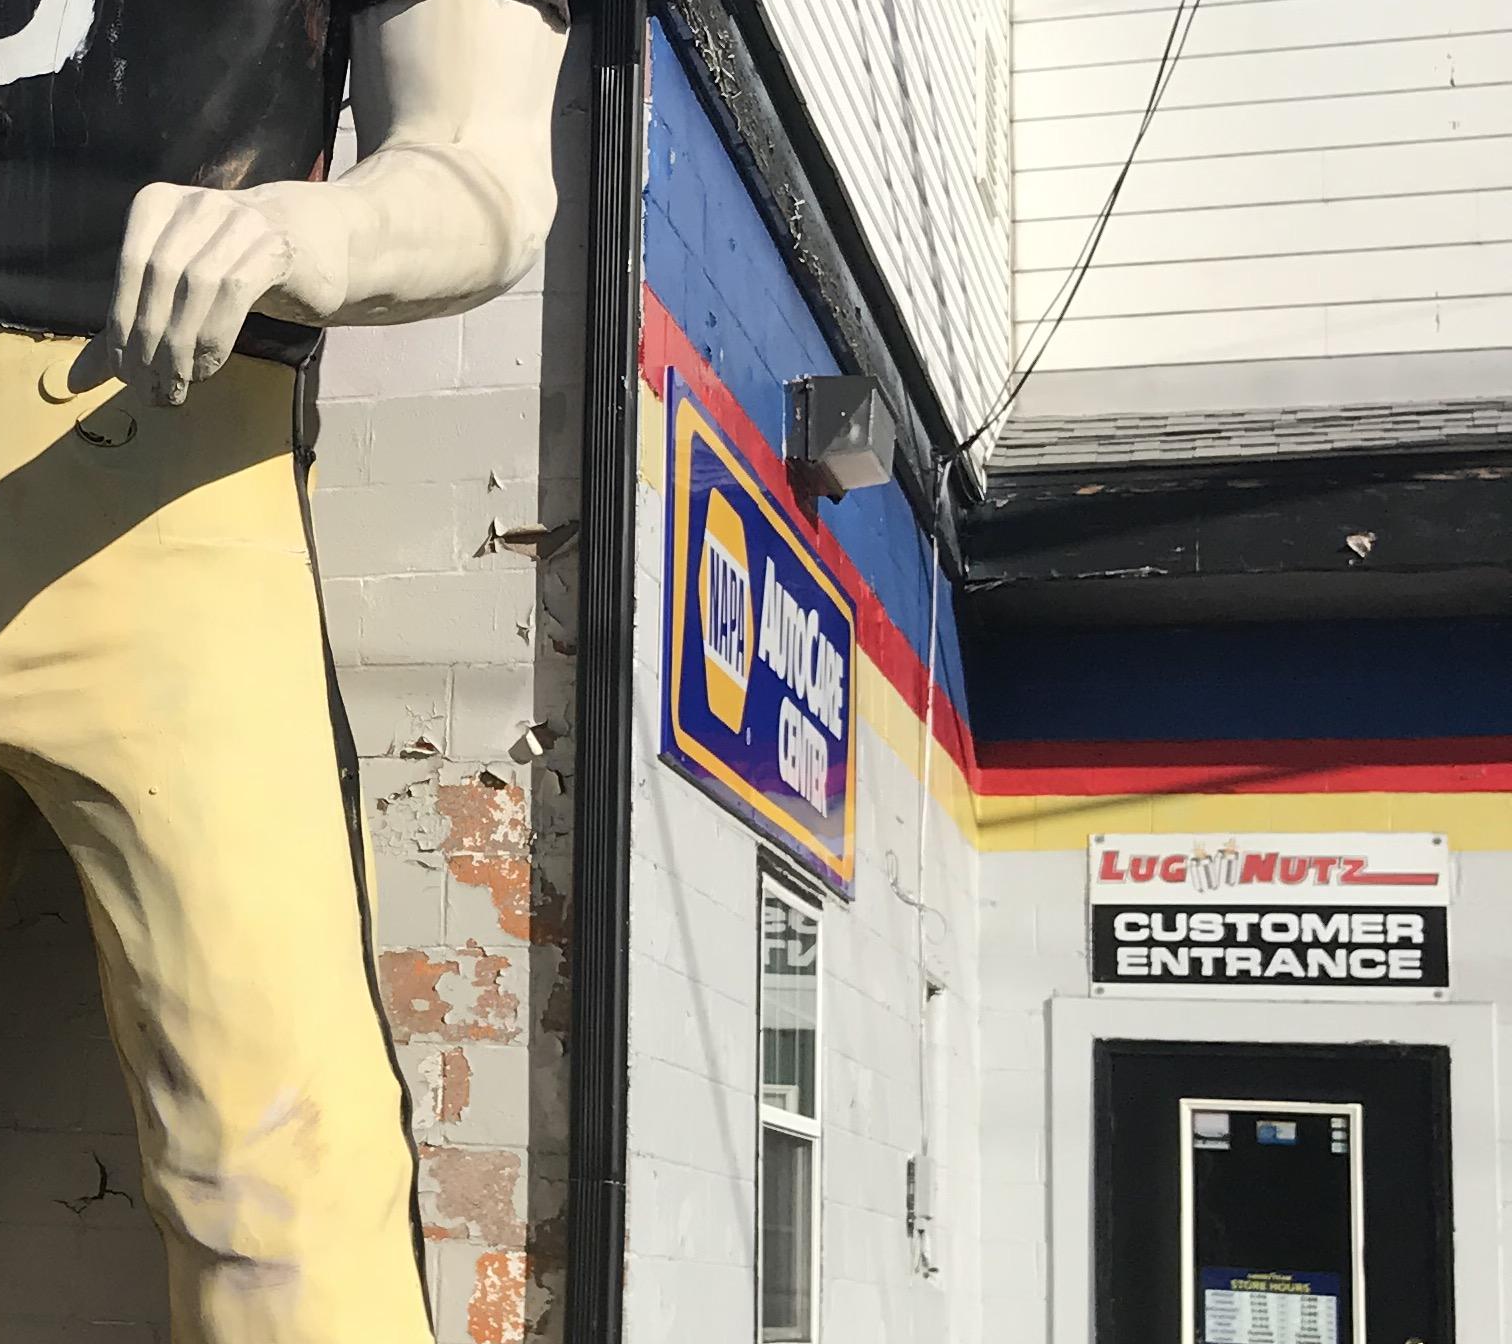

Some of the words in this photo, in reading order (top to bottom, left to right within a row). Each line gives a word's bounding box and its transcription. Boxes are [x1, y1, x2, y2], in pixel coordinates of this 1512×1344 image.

[708, 546, 746, 678] NAPA
[778, 696, 829, 818] CENTER
[1097, 850, 1187, 884] LUG
[1238, 851, 1438, 885] NUTZ
[1113, 912, 1424, 944] CUSTOMER
[1116, 946, 1423, 979] ENTRANCE
